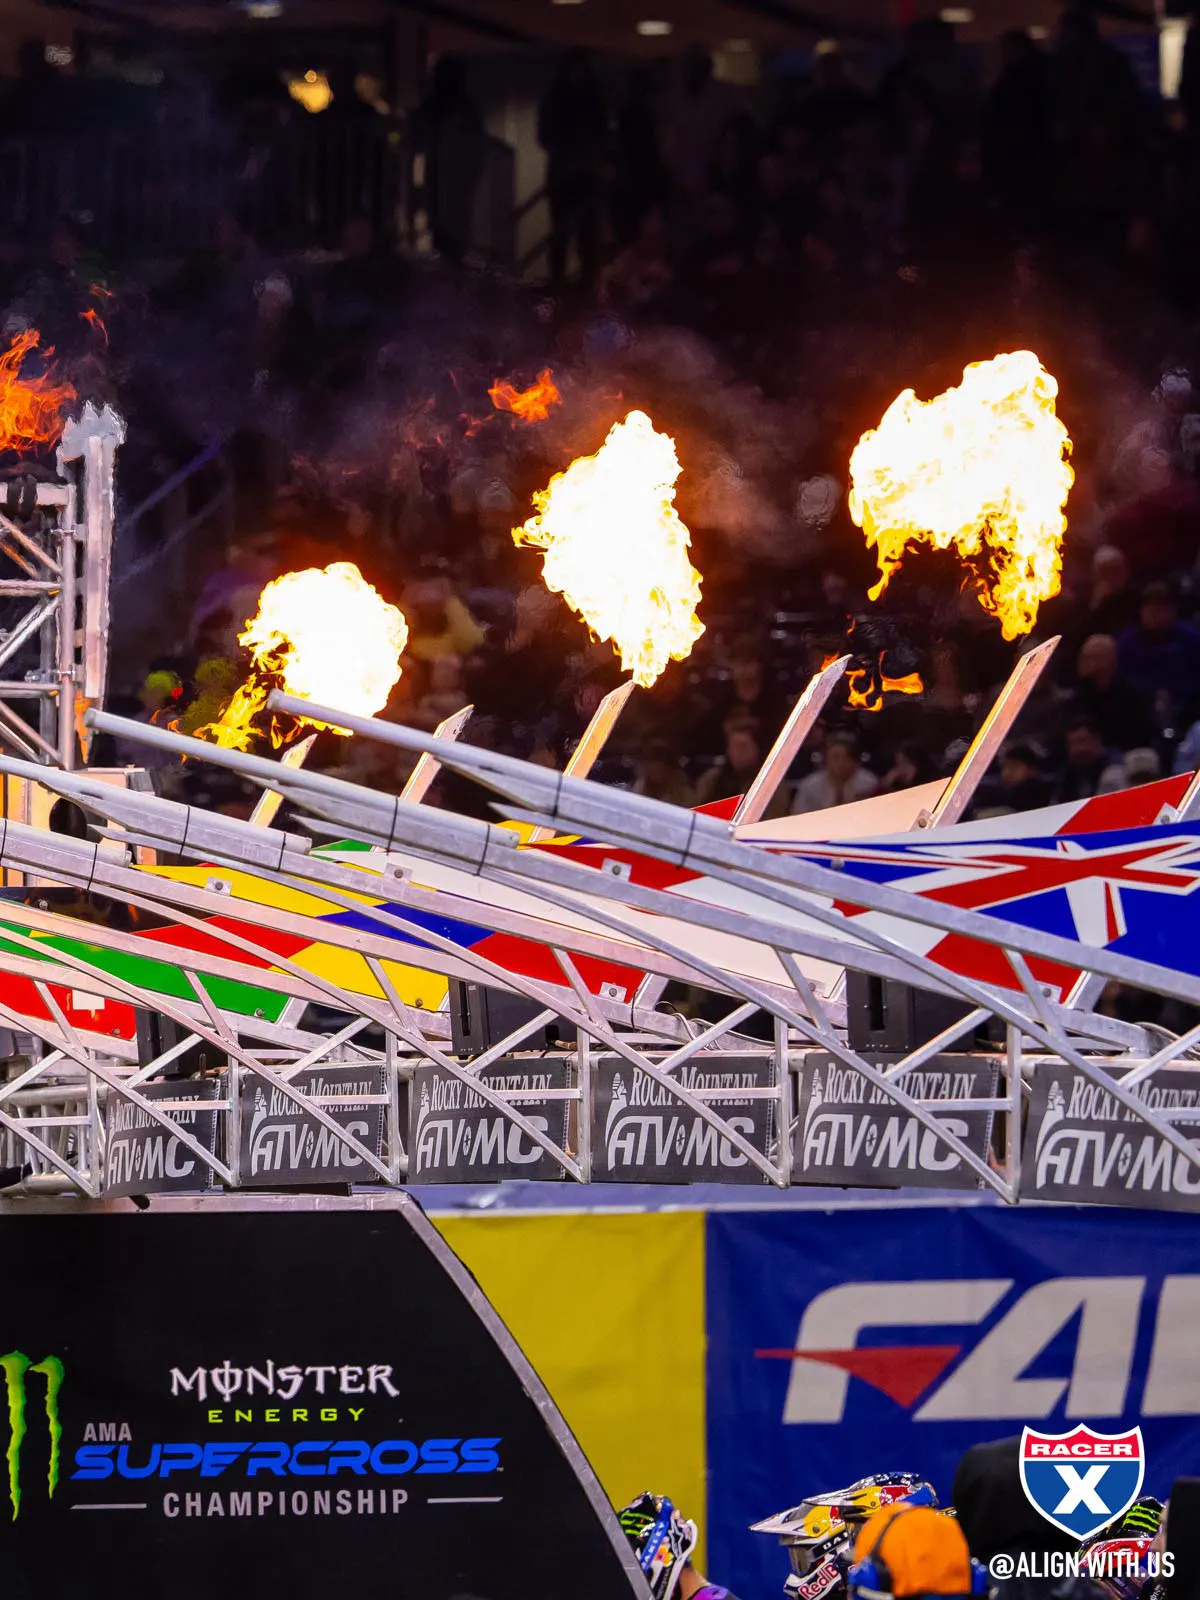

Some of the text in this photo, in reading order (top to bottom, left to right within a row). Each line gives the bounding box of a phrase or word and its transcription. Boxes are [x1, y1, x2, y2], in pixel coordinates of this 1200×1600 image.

[430, 1074, 463, 1112] ROCKY
[824, 1062, 868, 1104] ROCKY
[169, 1359, 401, 1403] MONSTER
[83, 1422, 133, 1442] AMA
[207, 1407, 366, 1424] ENERGY
[70, 1436, 504, 1481] SUPERCROSS
[163, 1489, 409, 1518] CHAMPIONSHIP
